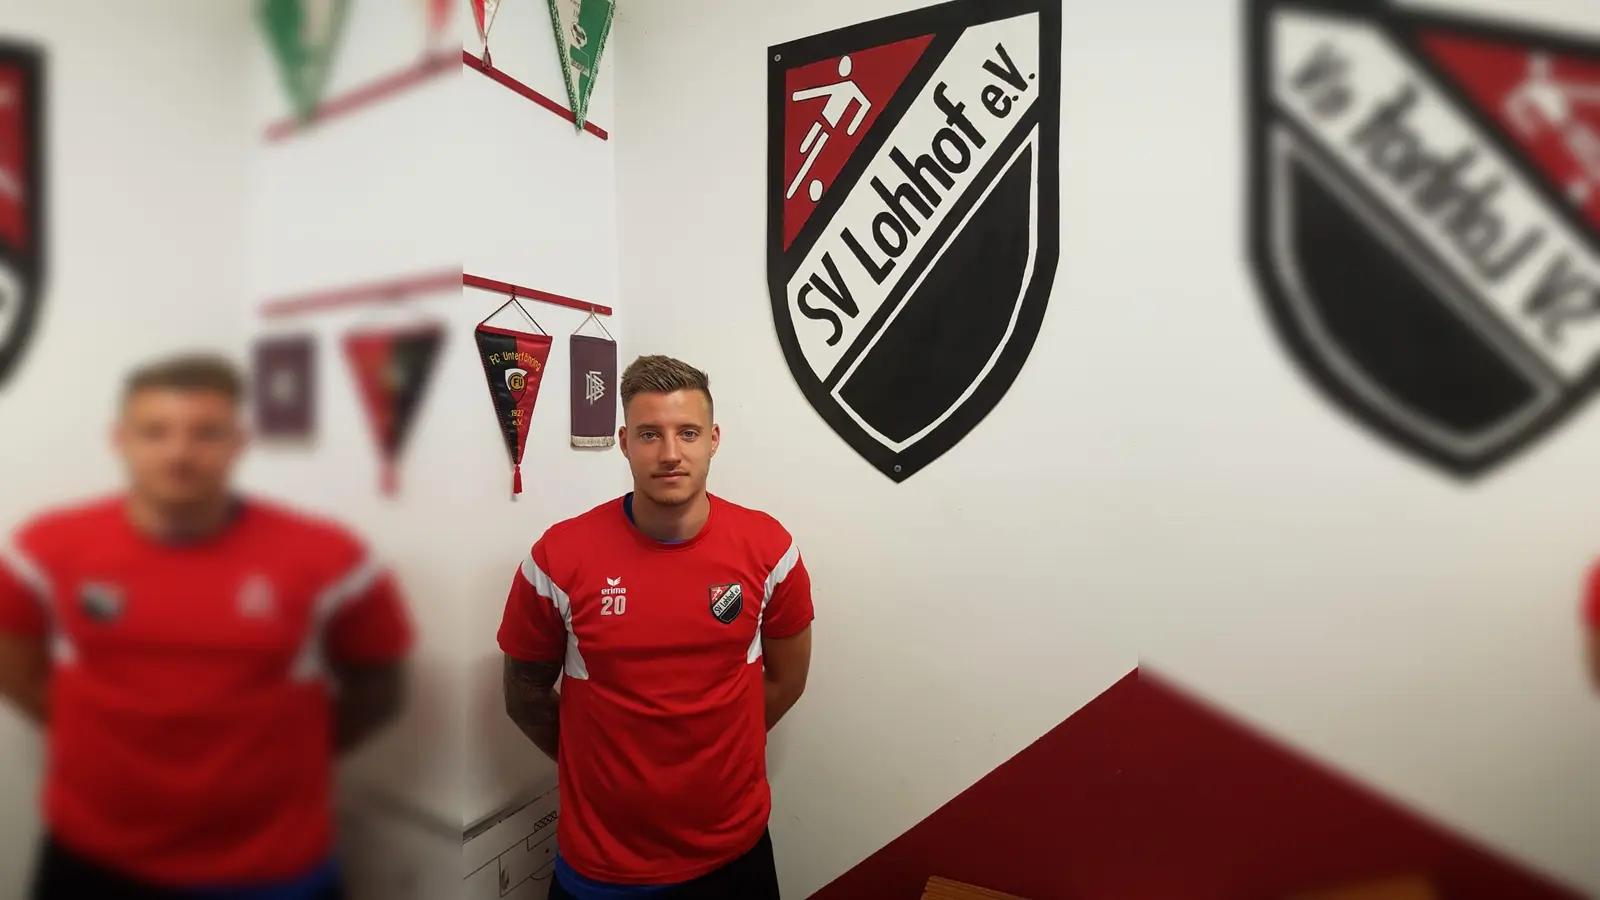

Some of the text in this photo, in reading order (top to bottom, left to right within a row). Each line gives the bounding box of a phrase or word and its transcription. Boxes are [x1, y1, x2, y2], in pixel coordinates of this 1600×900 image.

[797, 42, 1036, 347] SV Lohhof e.V.
[490, 351, 542, 372] FC Unterföhring
[511, 409, 524, 417] 1927
[601, 587, 627, 595] erima
[600, 595, 626, 616] 20
[714, 604, 723, 614] SV
